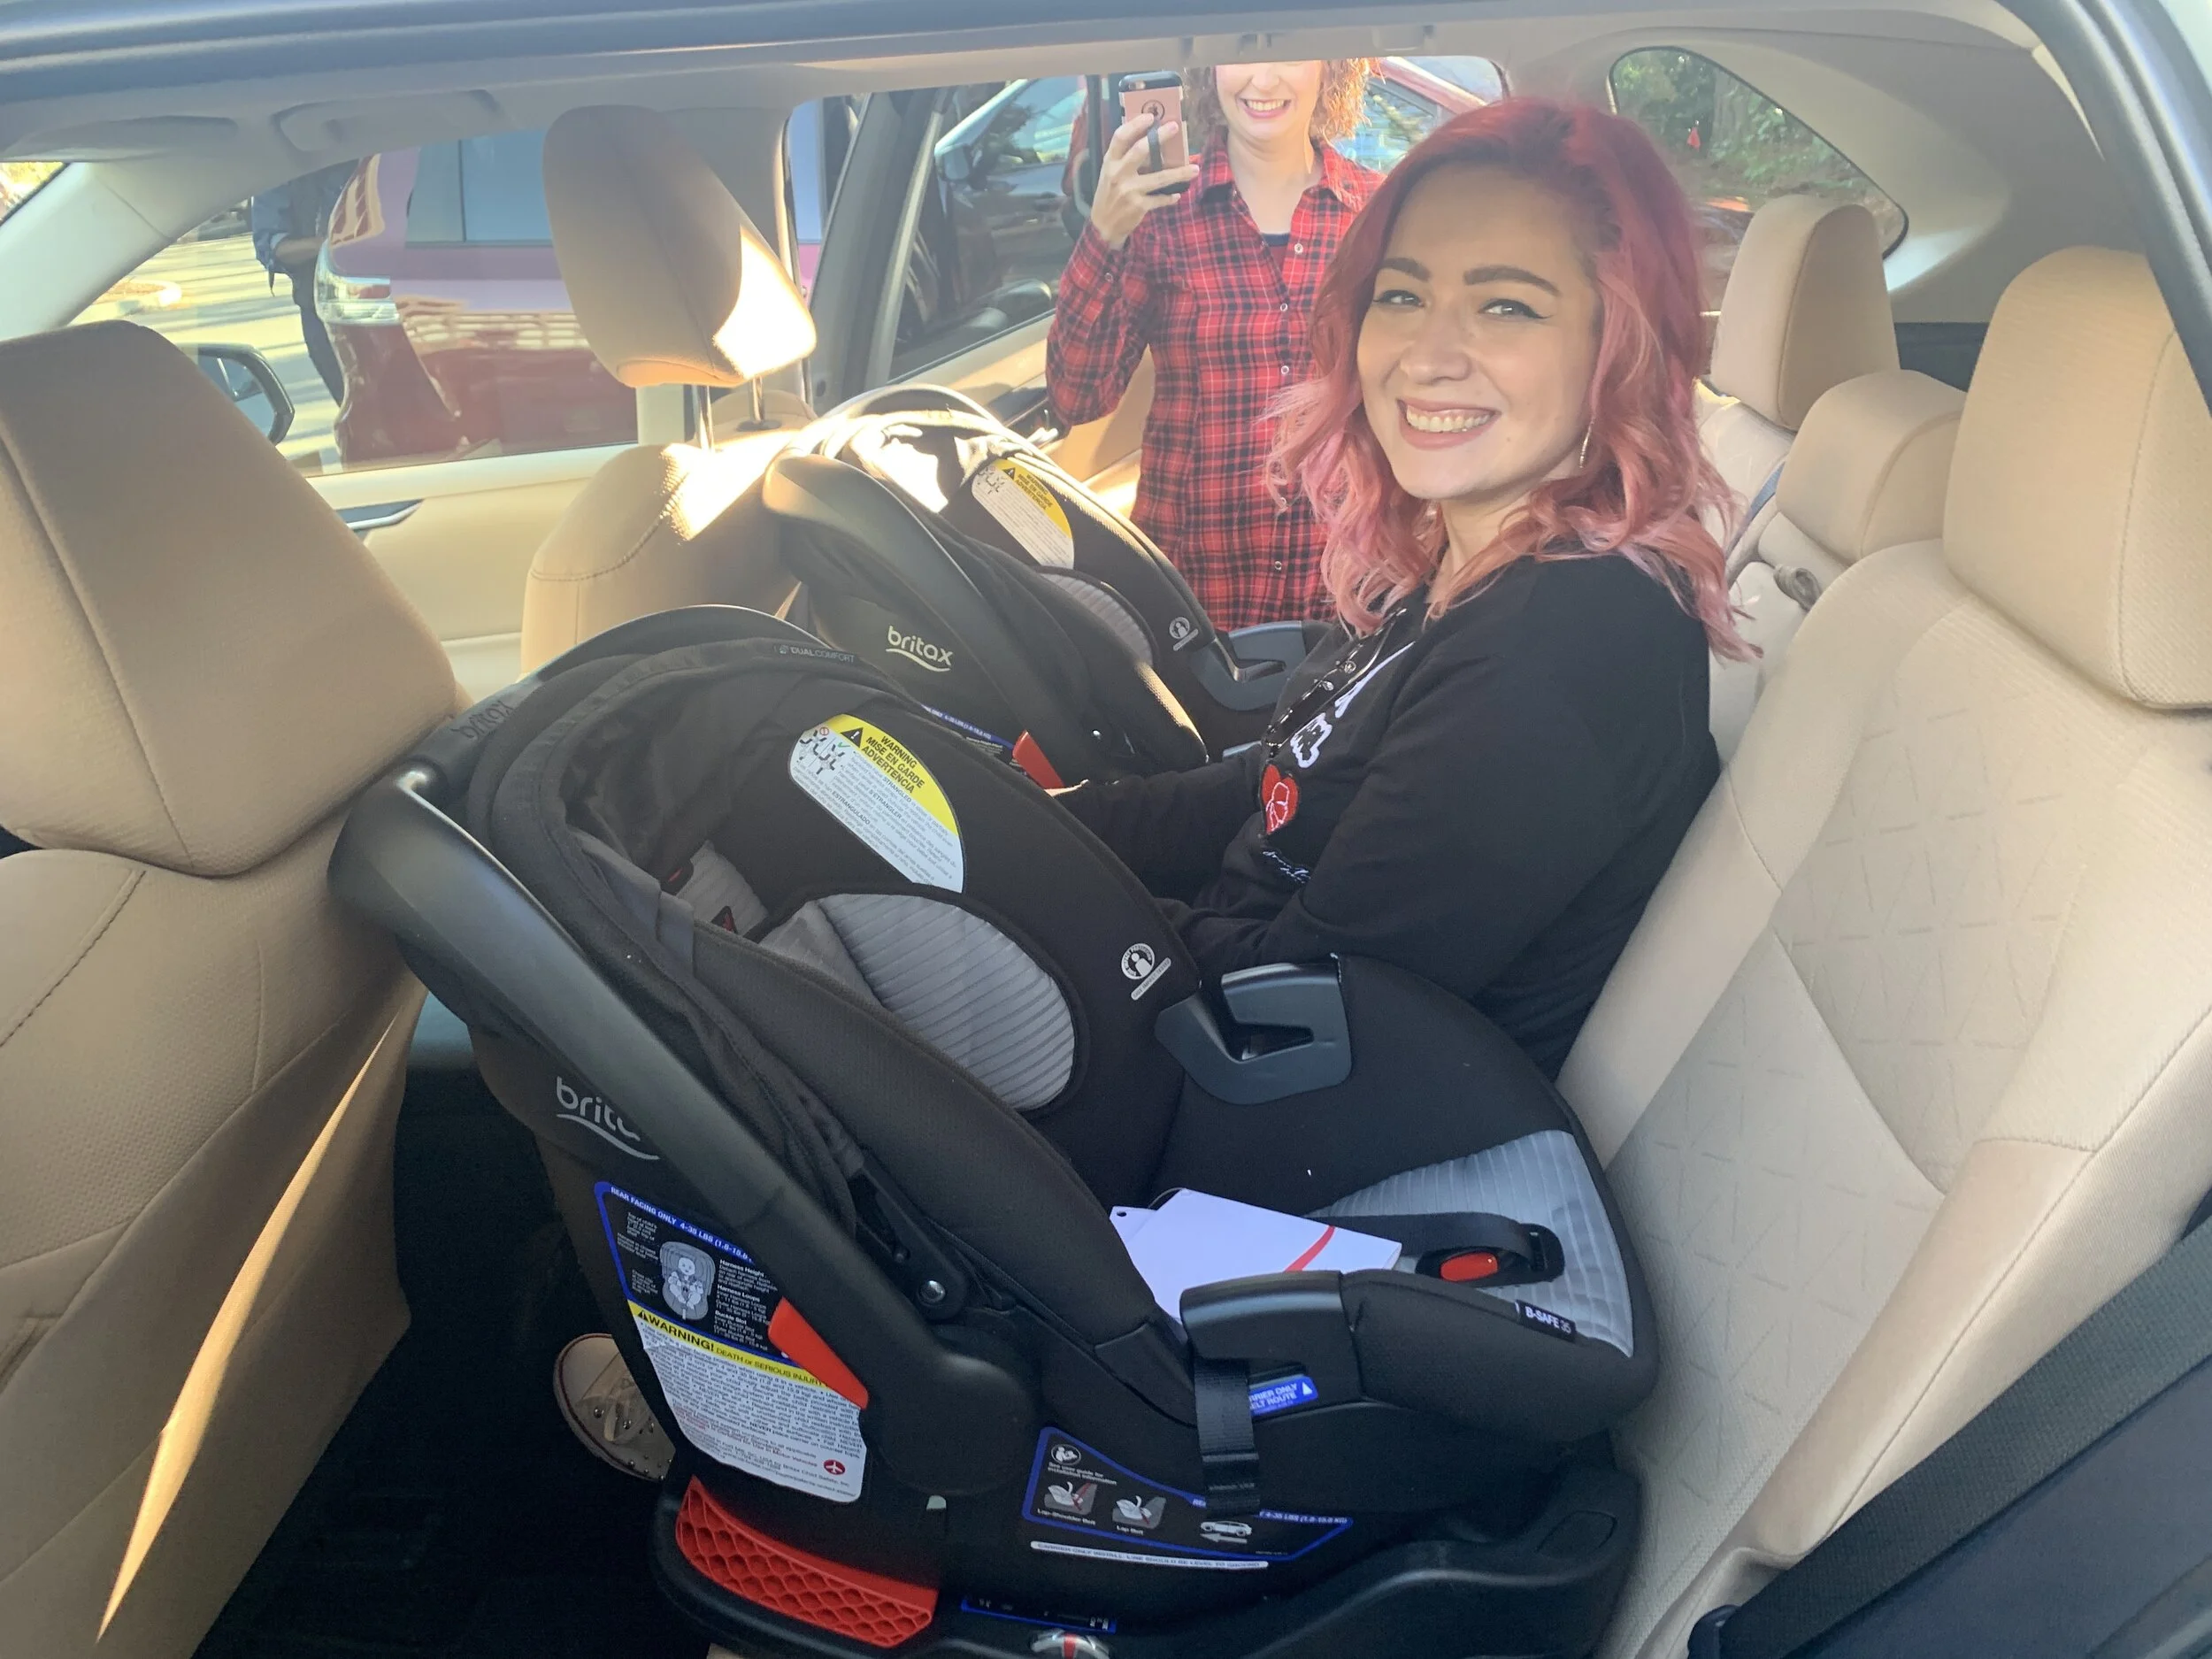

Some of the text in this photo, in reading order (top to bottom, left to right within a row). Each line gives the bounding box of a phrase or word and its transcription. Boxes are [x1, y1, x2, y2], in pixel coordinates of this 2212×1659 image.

[887, 625, 953, 665] britax
[860, 745, 915, 793] ADVERTENCIA
[865, 736, 886, 756] MISE
[885, 752, 898, 766] EN
[896, 762, 925, 789] GARDE
[879, 735, 918, 769] WARNING
[882, 776, 912, 803] STRANGLED
[832, 790, 870, 825] ESTRANGULADO
[556, 1076, 641, 1141] brit
[611, 1186, 630, 1201] REAR
[631, 1197, 657, 1214] FACING
[658, 1210, 676, 1225] ONLY
[680, 1222, 697, 1235] 4-35
[699, 1231, 713, 1243] LBS
[720, 1259, 764, 1277] Harness Height
[1525, 1305, 1573, 1333] B-SAFE 35
[650, 1315, 714, 1351] WARNING!
[716, 1347, 743, 1362] DEATH
[755, 1360, 790, 1377] SERIOUS
[1249, 1383, 1297, 1402] RRIER ONLY
[1250, 1399, 1266, 1410] ELT
[1267, 1391, 1297, 1405] ROUTE
[1038, 1508, 1081, 1522] Lap-Shoulder
